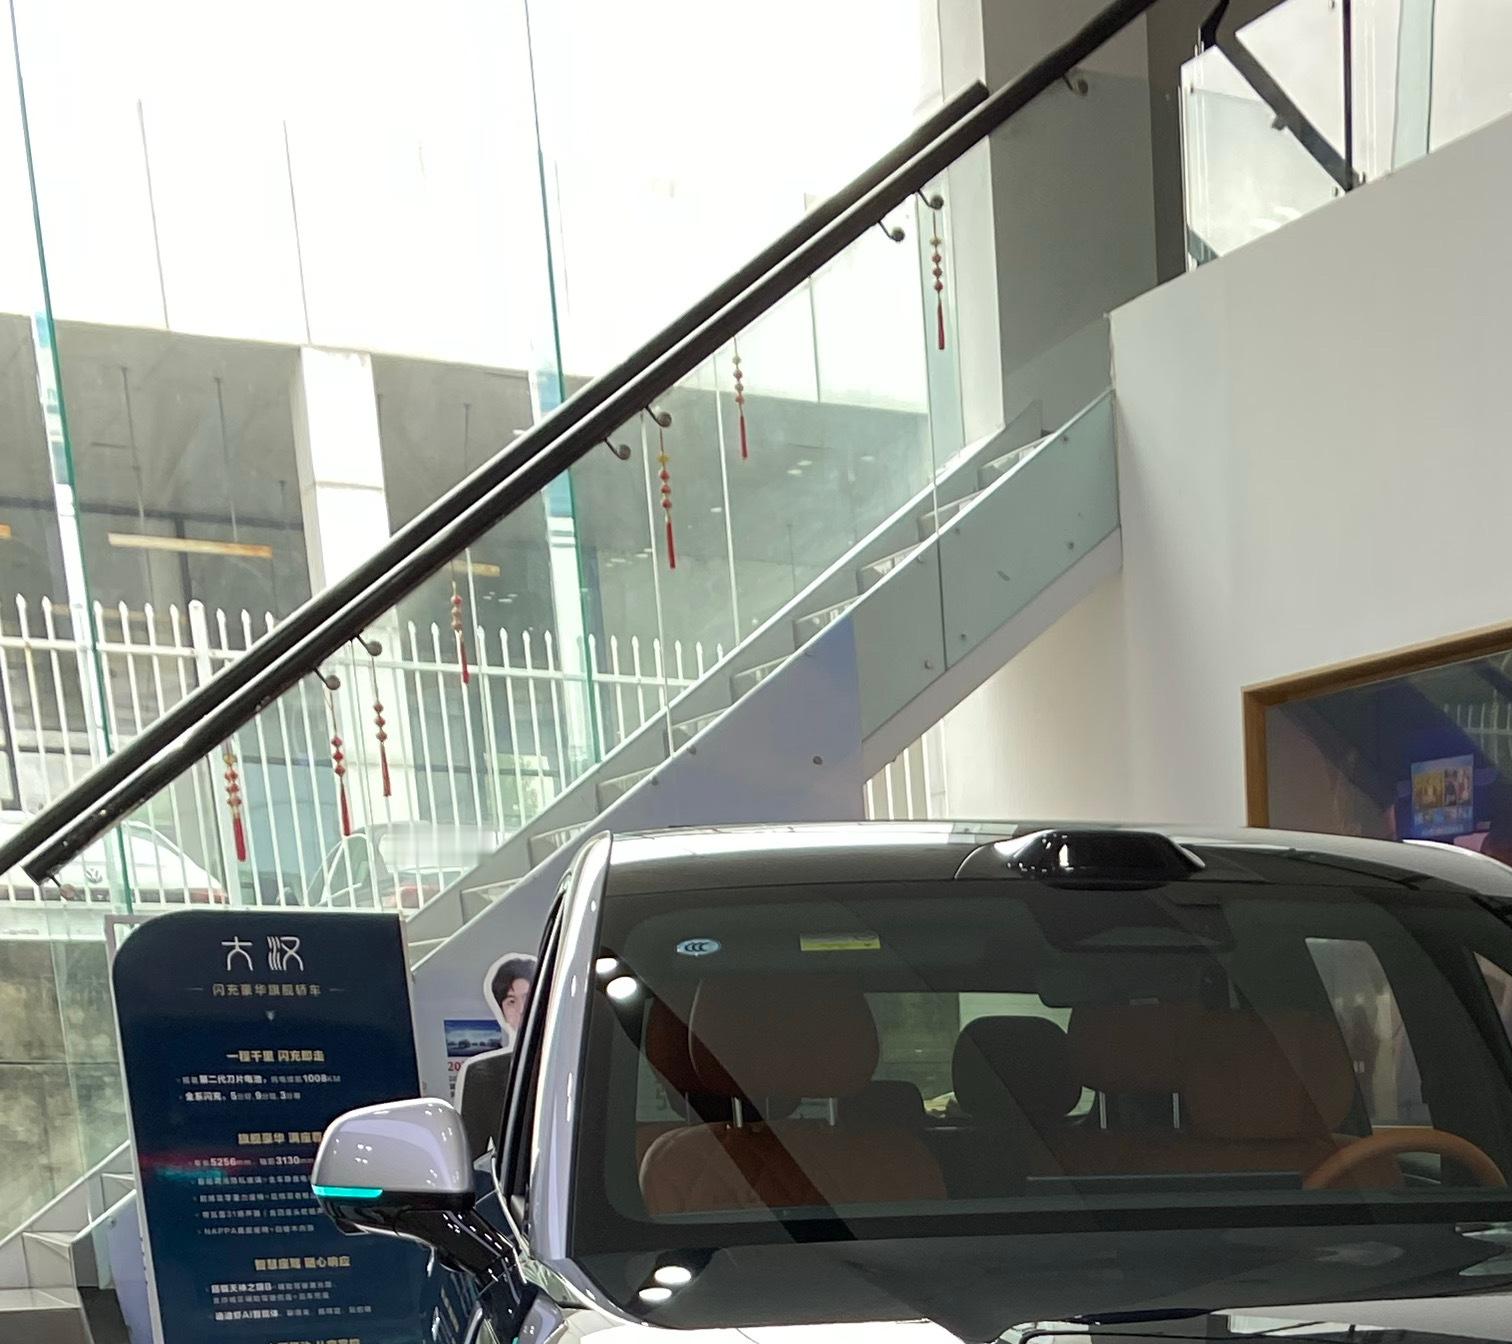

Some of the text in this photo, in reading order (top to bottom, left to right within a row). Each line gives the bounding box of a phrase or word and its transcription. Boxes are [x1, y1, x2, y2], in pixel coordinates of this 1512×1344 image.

[221, 935, 304, 972] 大汉
[212, 983, 321, 997] 闪充豪华旗舰轿车
